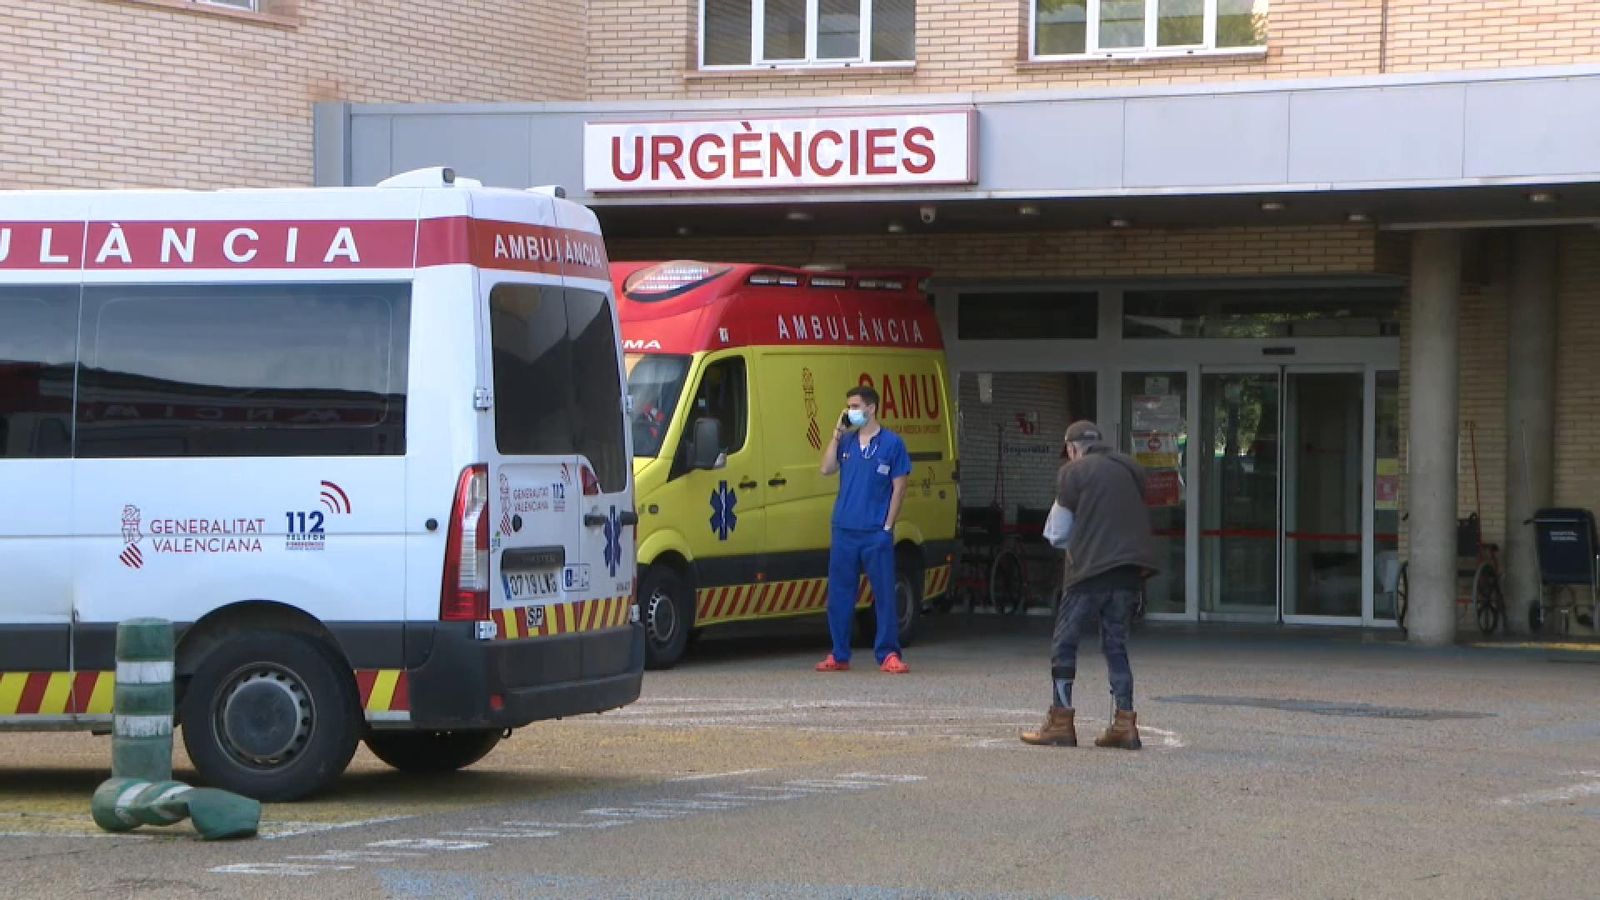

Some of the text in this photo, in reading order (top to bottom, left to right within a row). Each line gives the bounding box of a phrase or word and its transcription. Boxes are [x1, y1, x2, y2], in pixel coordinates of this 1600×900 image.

[611, 121, 935, 182] URGÈNCIES
[493, 233, 602, 268] AMBULÀNCIA
[778, 312, 924, 343] AMBULÀNCIA
[620, 339, 661, 350] MA
[149, 519, 265, 534] GENERALITAT
[286, 511, 324, 533] 112
[152, 538, 263, 553] VALENCIANA
[510, 575, 537, 595] 0719
[528, 608, 543, 625] SP
